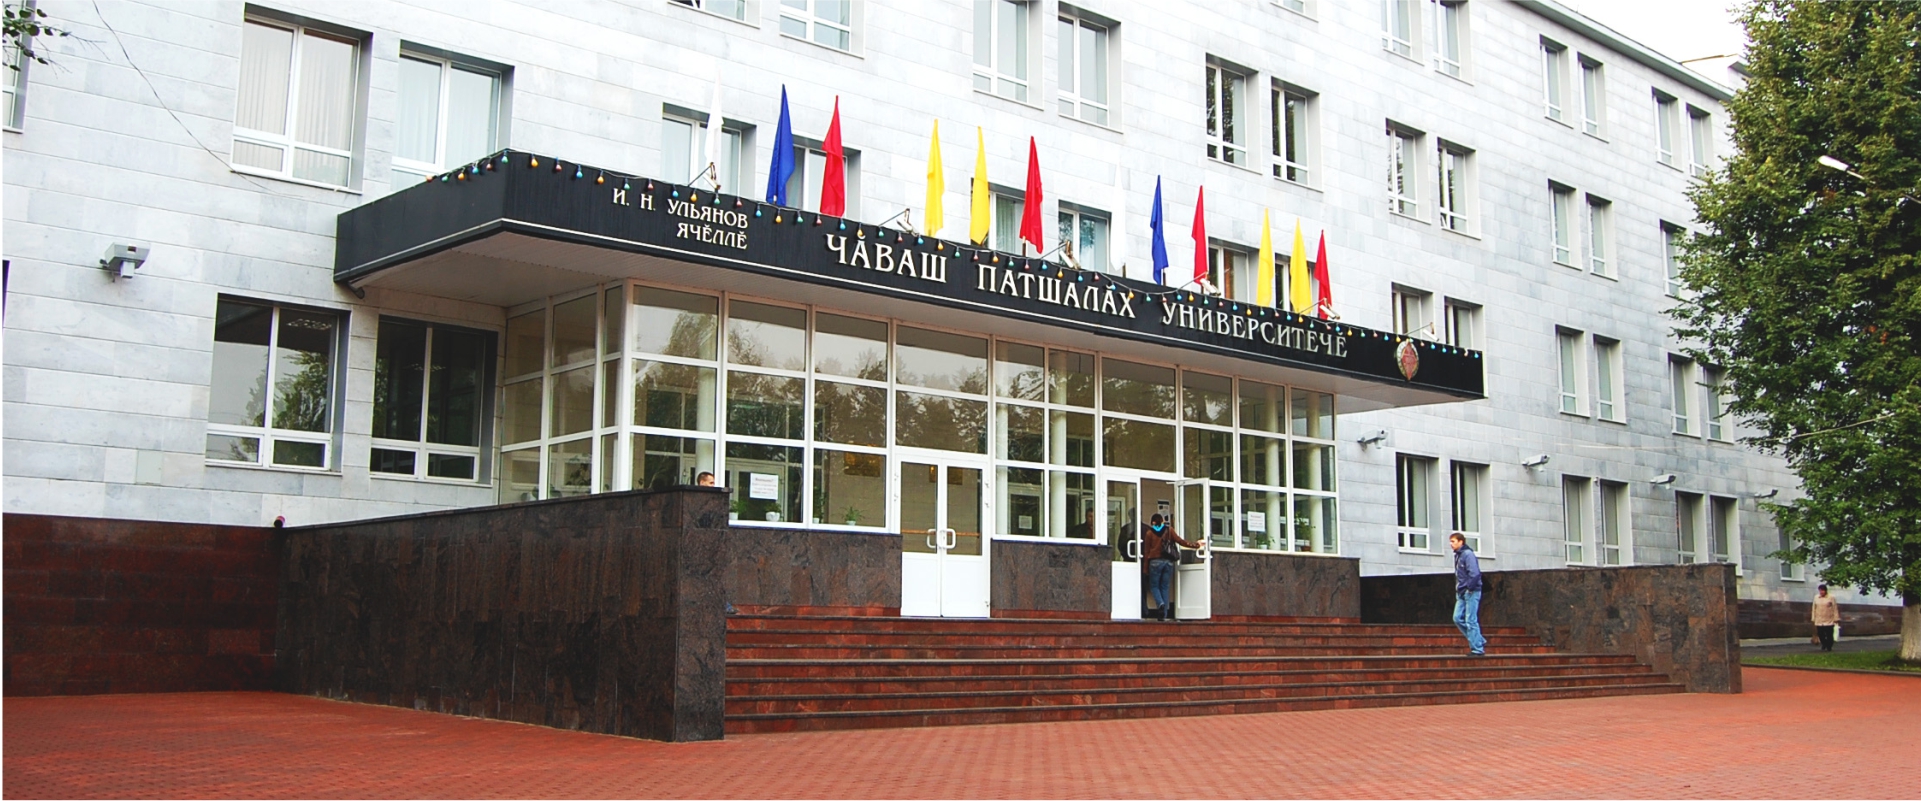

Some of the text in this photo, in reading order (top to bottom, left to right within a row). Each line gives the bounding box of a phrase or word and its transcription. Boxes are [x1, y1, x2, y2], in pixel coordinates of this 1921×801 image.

[613, 187, 748, 229] И. Н. УЛЬЯНОВ
[676, 222, 748, 249] ЯЧӖЛЛӖ
[826, 233, 1348, 358] ЧӐВАШ ПАТШАЛӐХ УНИВЕРСИТЕЧӖ
